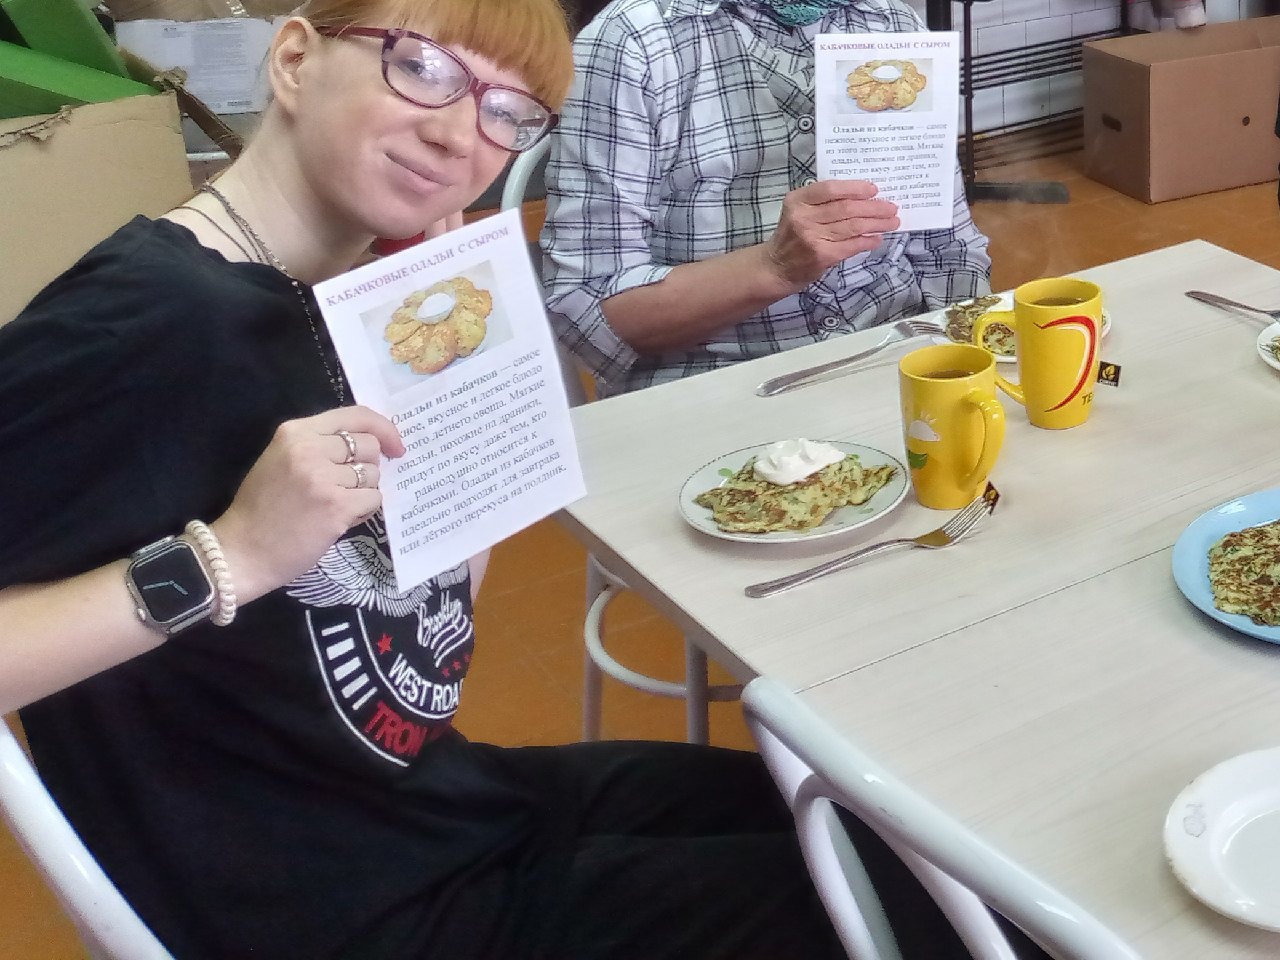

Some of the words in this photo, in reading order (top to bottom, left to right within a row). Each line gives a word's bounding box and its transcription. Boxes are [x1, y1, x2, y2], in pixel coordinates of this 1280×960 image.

[820, 42, 875, 50] КАБАЧКОВЫЕ
[326, 266, 409, 307] КАБАЧКОВЫЕ
[410, 247, 455, 274] ОЛАДЬИ
[457, 242, 466, 254] С
[467, 226, 508, 250] СЫРОМ
[390, 398, 433, 426] Оладьи
[435, 393, 448, 405] из
[449, 367, 498, 398] кабачков
[512, 348, 541, 368] самое
[426, 399, 469, 428] вкусное
[470, 396, 477, 405] и
[478, 379, 511, 401] легкое
[511, 362, 543, 385] блюдо
[431, 415, 471, 441] летнего
[508, 377, 545, 402] Мягкие
[396, 448, 437, 474] оладьи,
[439, 425, 483, 452] похожие
[484, 419, 496, 430] на
[396, 465, 436, 493] придут
[437, 458, 450, 471] по
[452, 443, 481, 465] вкусу
[482, 429, 507, 448] даже
[509, 418, 529, 434] тем,
[530, 409, 547, 424] кто
[399, 484, 458, 522] кабачками.
[460, 464, 498, 491] Оладьи
[500, 459, 511, 471] из
[512, 435, 554, 464] кабачков
[414, 460, 479, 501] равнодушно
[479, 435, 528, 465] относится
[530, 430, 537, 440] к
[399, 538, 420, 556] или
[420, 515, 462, 545] лёгкого
[464, 493, 509, 525] перекуса
[510, 486, 522, 498] на
[524, 462, 566, 491] полдник.
[401, 506, 451, 539] идеально
[453, 482, 498, 512] подходят
[500, 472, 518, 488] для
[519, 450, 560, 480] завтрака
[388, 653, 432, 706] WEST
[430, 678, 464, 711] ROA
